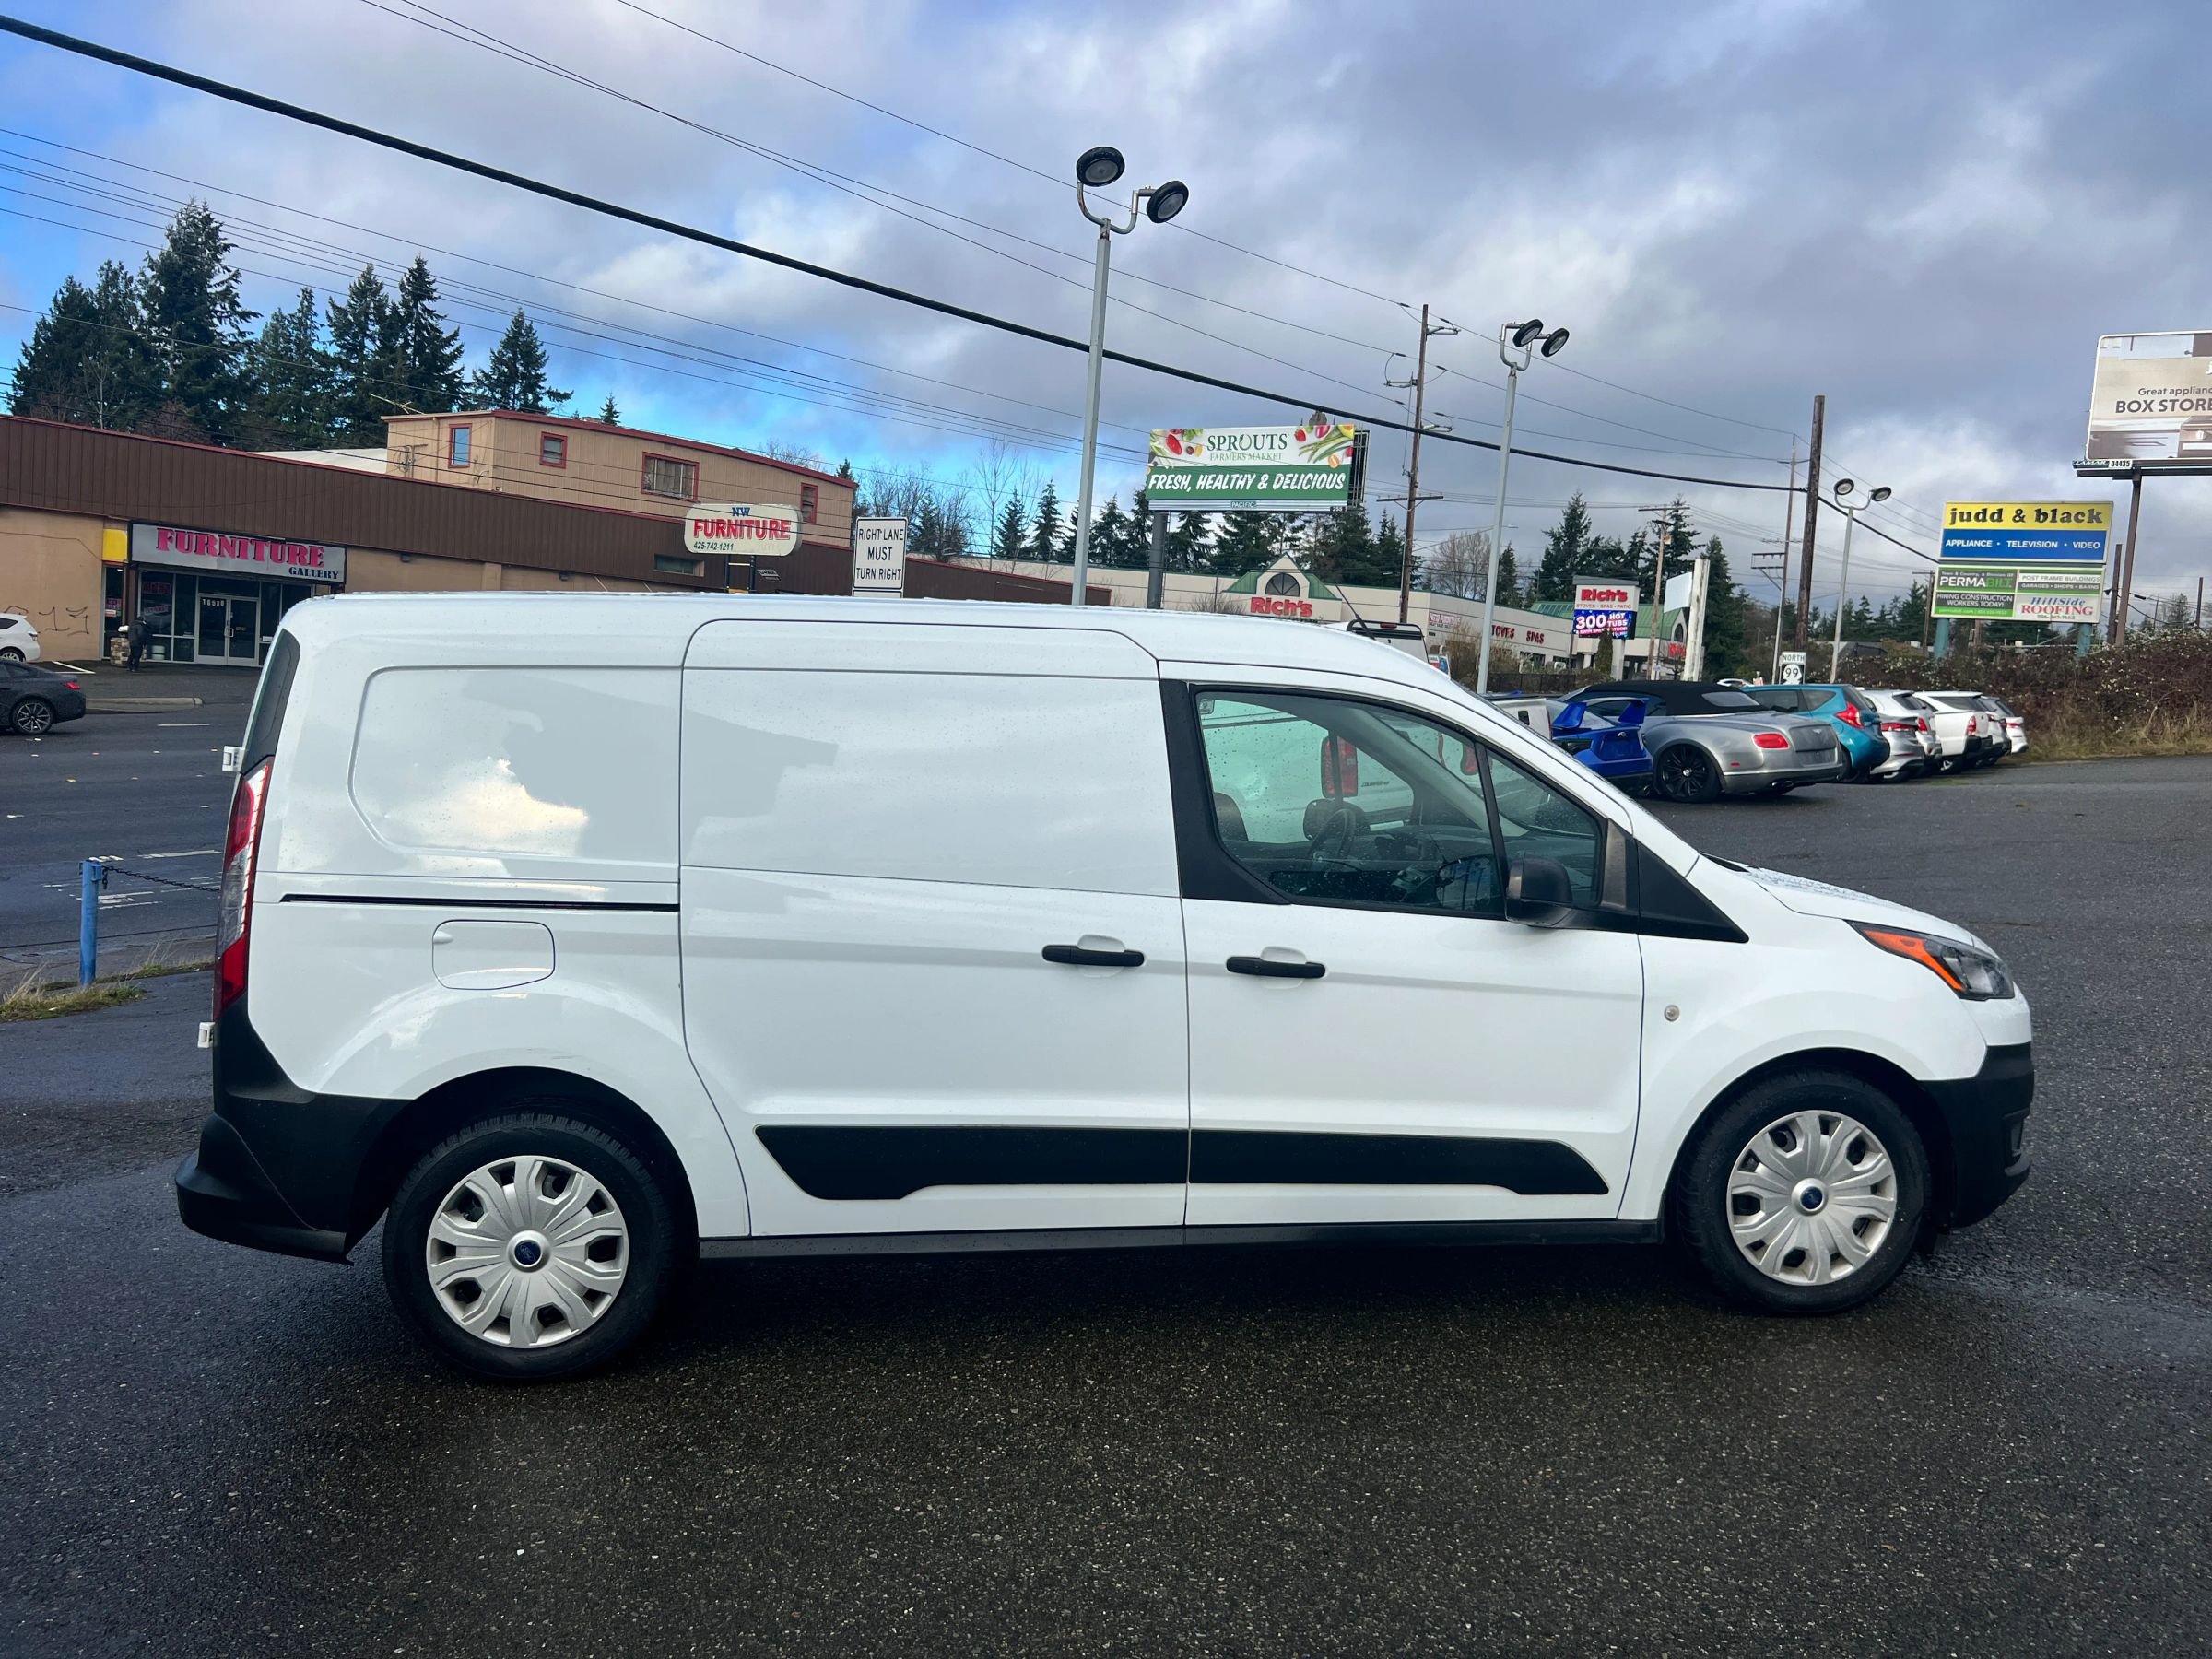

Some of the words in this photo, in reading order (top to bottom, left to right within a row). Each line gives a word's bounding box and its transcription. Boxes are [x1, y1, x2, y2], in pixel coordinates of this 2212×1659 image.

[2138, 387, 2167, 396] Great
[2115, 400, 2154, 414] BOX
[1206, 433, 1288, 452] SPROUTS
[1209, 453, 1247, 462] FARMERS
[1248, 452, 1283, 461] MARKET
[1147, 474, 1193, 493] FRESH,
[1195, 473, 1257, 491] HEALTHY
[1257, 474, 1269, 490] &
[1272, 472, 1346, 490] DELICIOUS
[731, 507, 751, 517] NW
[1948, 507, 2004, 526] judd
[2012, 508, 2026, 524] &
[2034, 508, 2103, 524] black
[693, 518, 792, 541] FURNITURE
[858, 528, 882, 541] RIGHT
[883, 528, 904, 541] LANE
[155, 526, 325, 568] FURNITURE
[693, 541, 735, 551] 425-742-1211
[1945, 539, 1993, 548] APPLIANCE
[2006, 540, 2058, 549] TELEVISION
[2073, 541, 2100, 549] VIDEO
[867, 546, 893, 561] MUST
[288, 566, 340, 581] GALLERY
[856, 567, 877, 580] TURN
[878, 568, 902, 581] RIGHT
[1581, 589, 1628, 602] Rich's
[1960, 594, 2014, 602] CONSTRUCTION
[1250, 596, 1313, 618] Rich's
[1947, 599, 1979, 607] WORKERS
[1610, 612, 1626, 620] HOT
[2020, 604, 2095, 616] ROOFING
[1576, 614, 1606, 629] 300
[1491, 624, 1516, 640] TOVES
[1525, 630, 1545, 644] SPAS
[1785, 667, 1799, 678] 99
